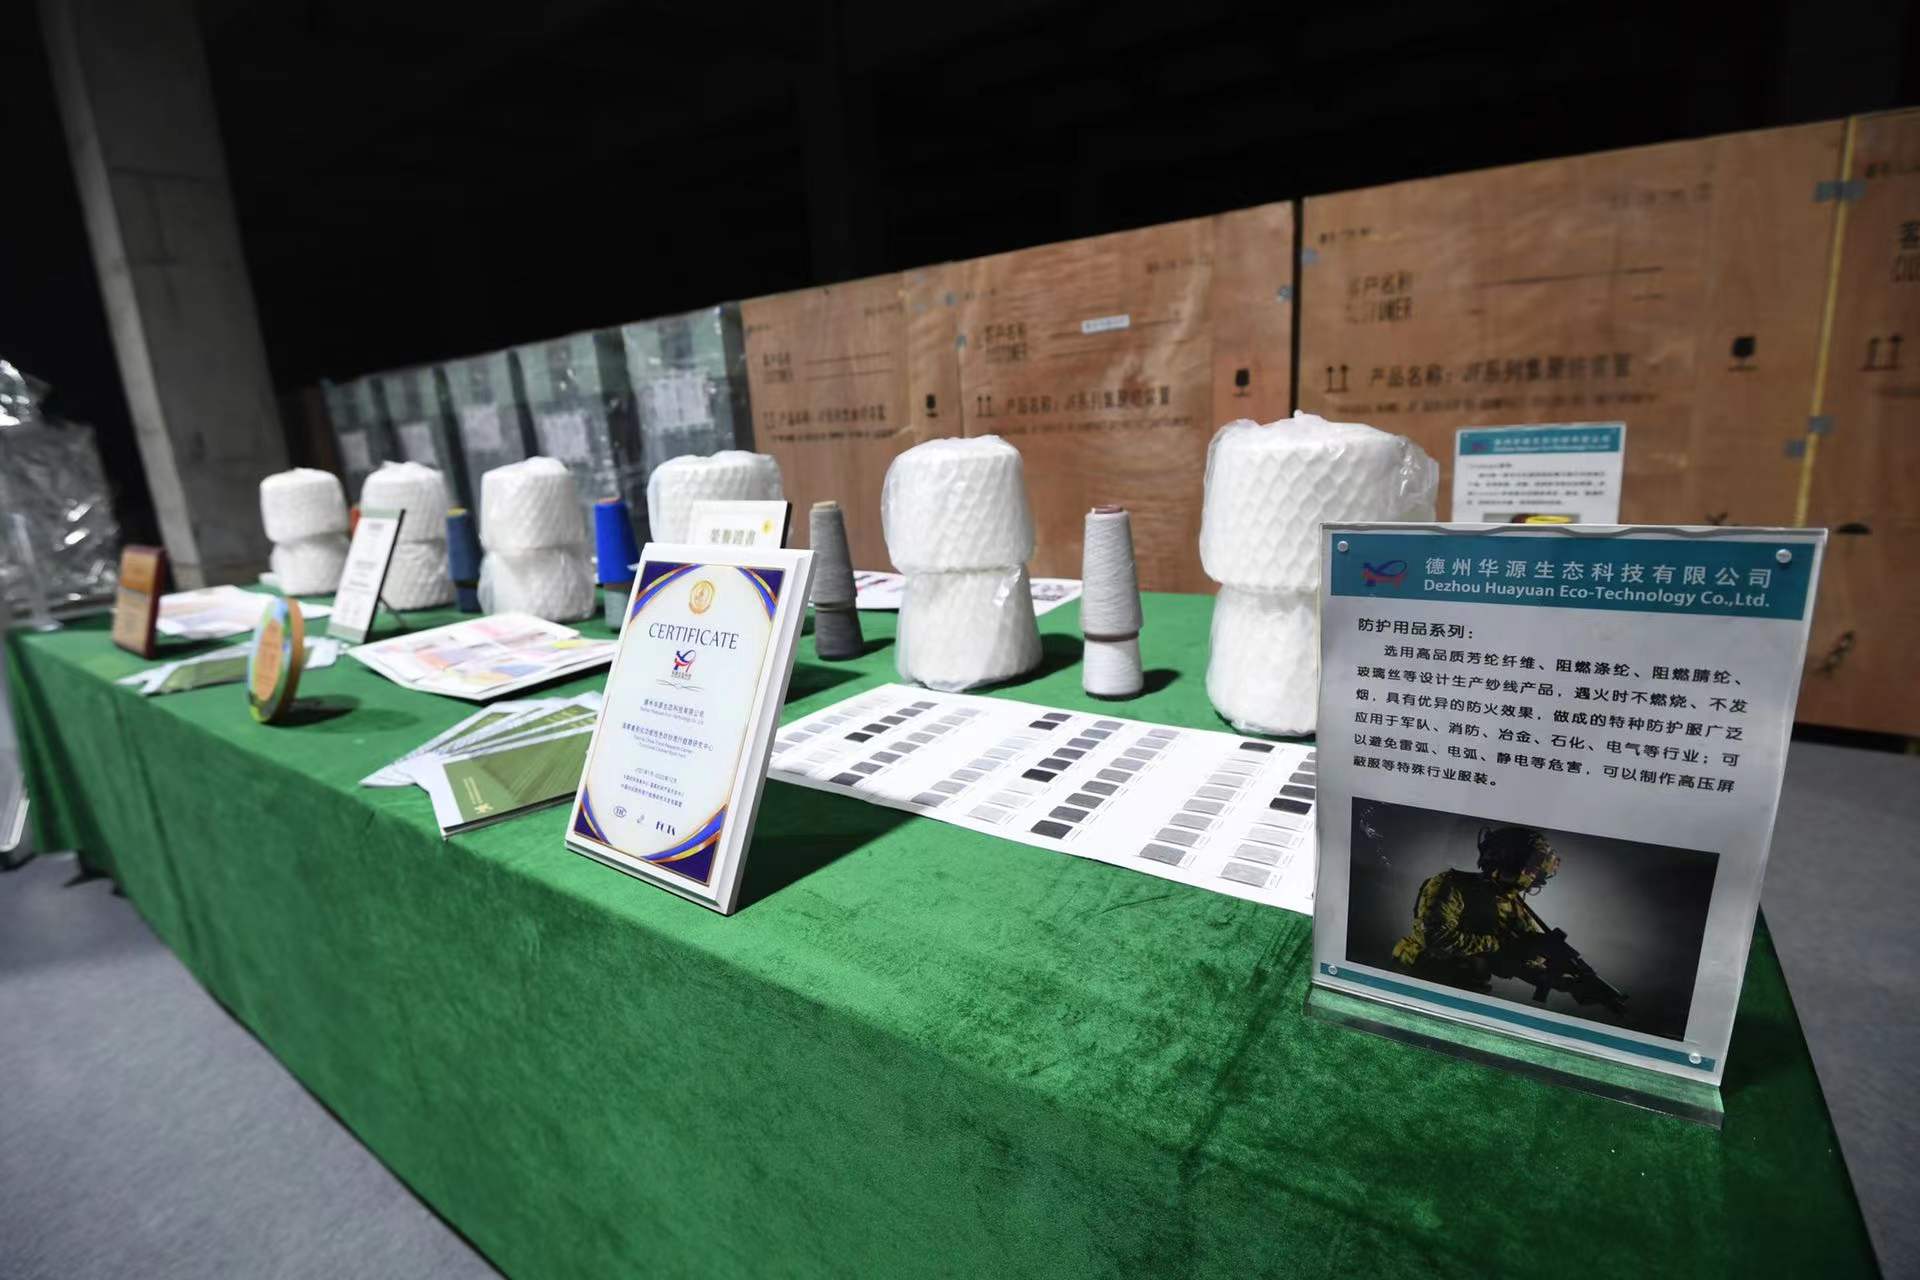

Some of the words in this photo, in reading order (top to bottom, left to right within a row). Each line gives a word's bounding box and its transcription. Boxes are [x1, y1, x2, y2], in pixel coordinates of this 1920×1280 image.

[1425, 557, 1772, 589] 德州华源生态科技有限公司
[1424, 579, 1480, 594] Dezhou
[1485, 582, 1554, 599] Huayuan
[1560, 585, 1696, 607] Eco-Technology
[1701, 591, 1770, 608] Co.,Ltd.
[649, 622, 739, 650] CERTIFICATE
[1358, 618, 1473, 639] 防护用品系列：
[1353, 756, 1497, 786] 蔽服等特殊行业服装。
